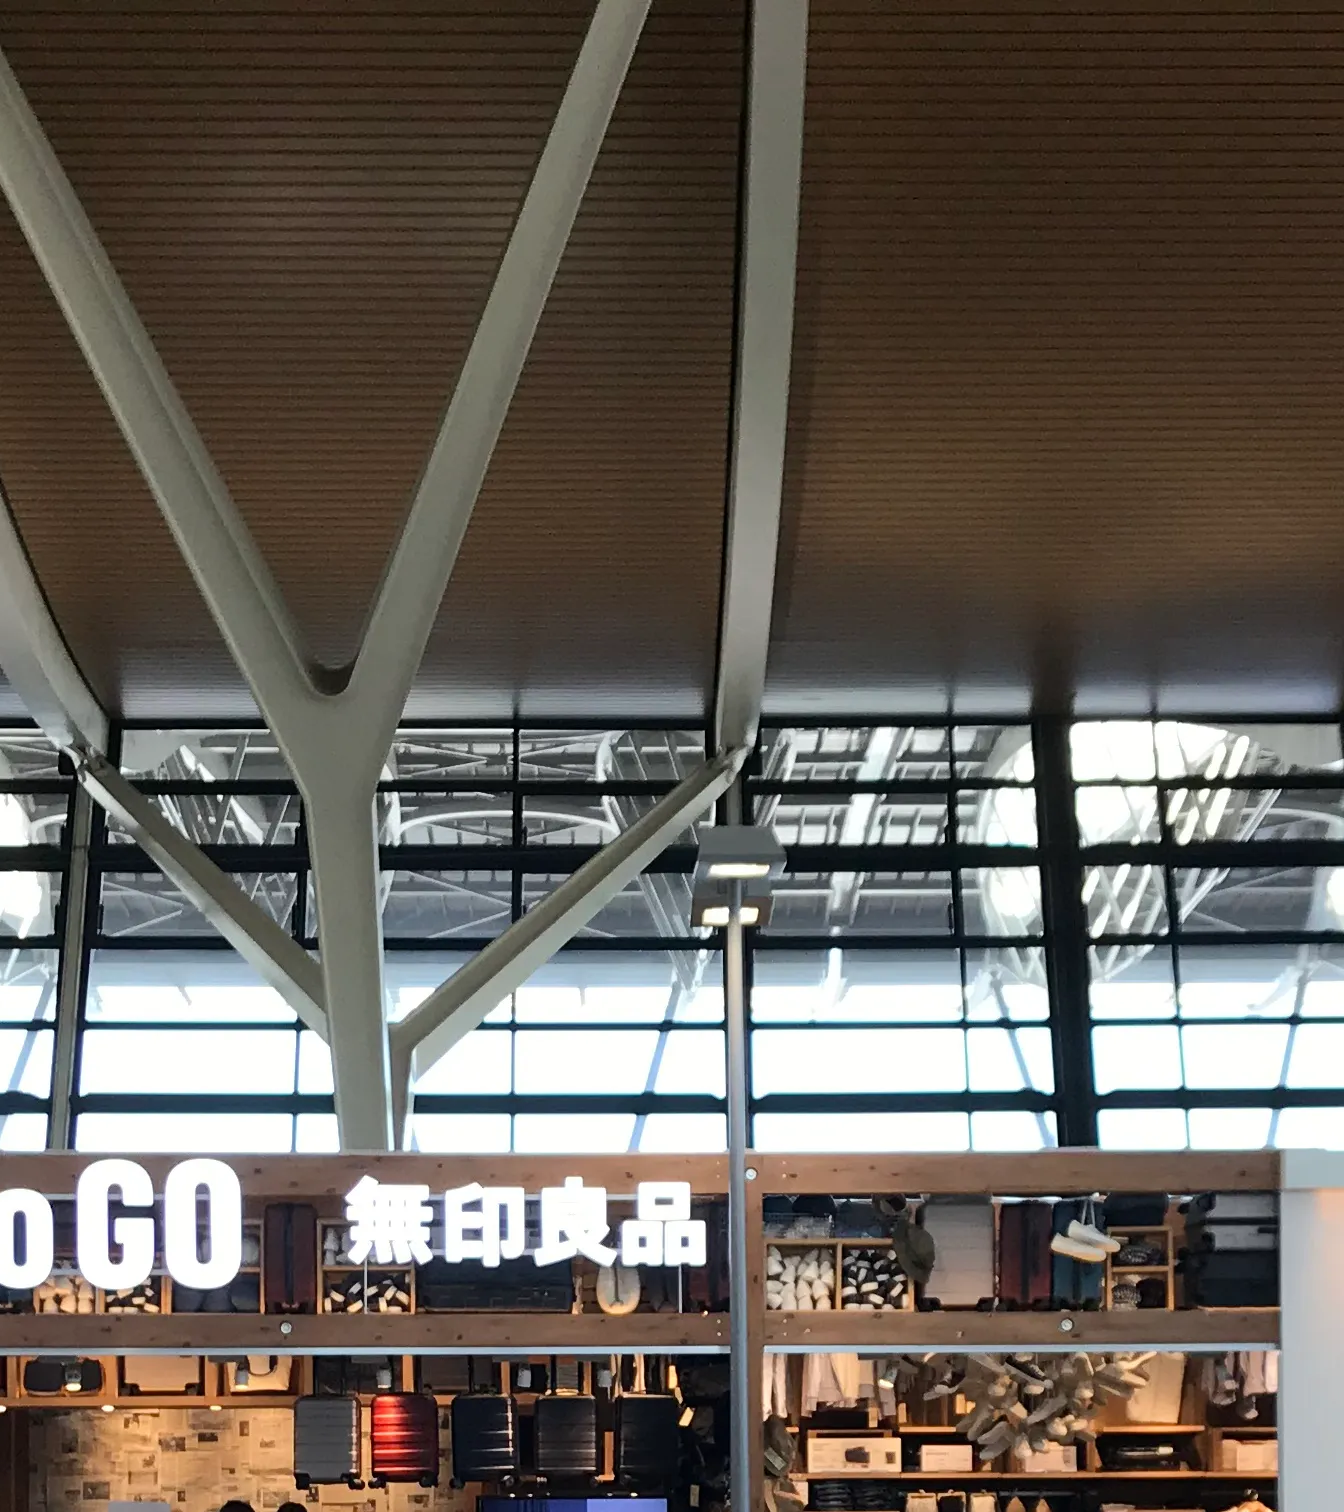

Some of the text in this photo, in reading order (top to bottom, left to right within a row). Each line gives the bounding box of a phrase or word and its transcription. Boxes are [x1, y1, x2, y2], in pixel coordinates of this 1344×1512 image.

[76, 1158, 242, 1290] GO
[345, 1175, 707, 1268] 無印良品
